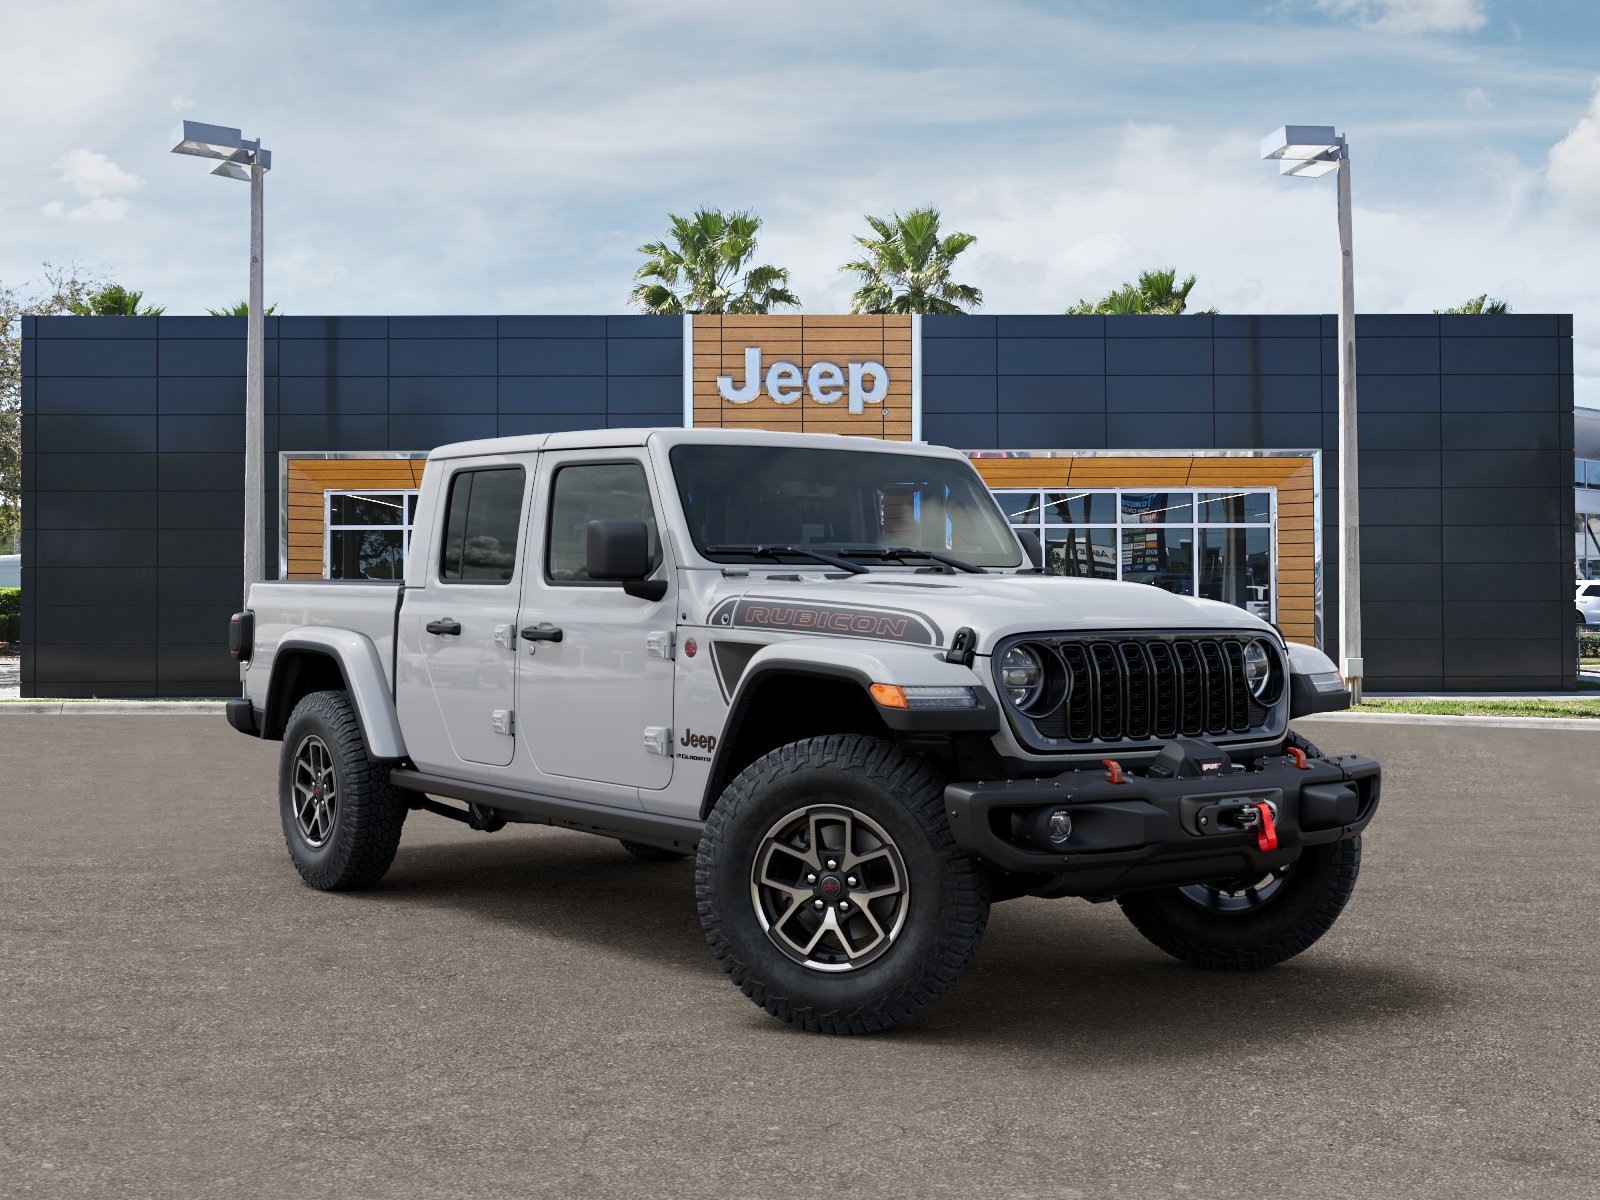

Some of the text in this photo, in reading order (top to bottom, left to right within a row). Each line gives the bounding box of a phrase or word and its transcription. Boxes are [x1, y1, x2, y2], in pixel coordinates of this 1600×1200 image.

[717, 347, 889, 414] Jeep
[745, 606, 908, 636] RUBICON
[681, 728, 716, 753] Jeep
